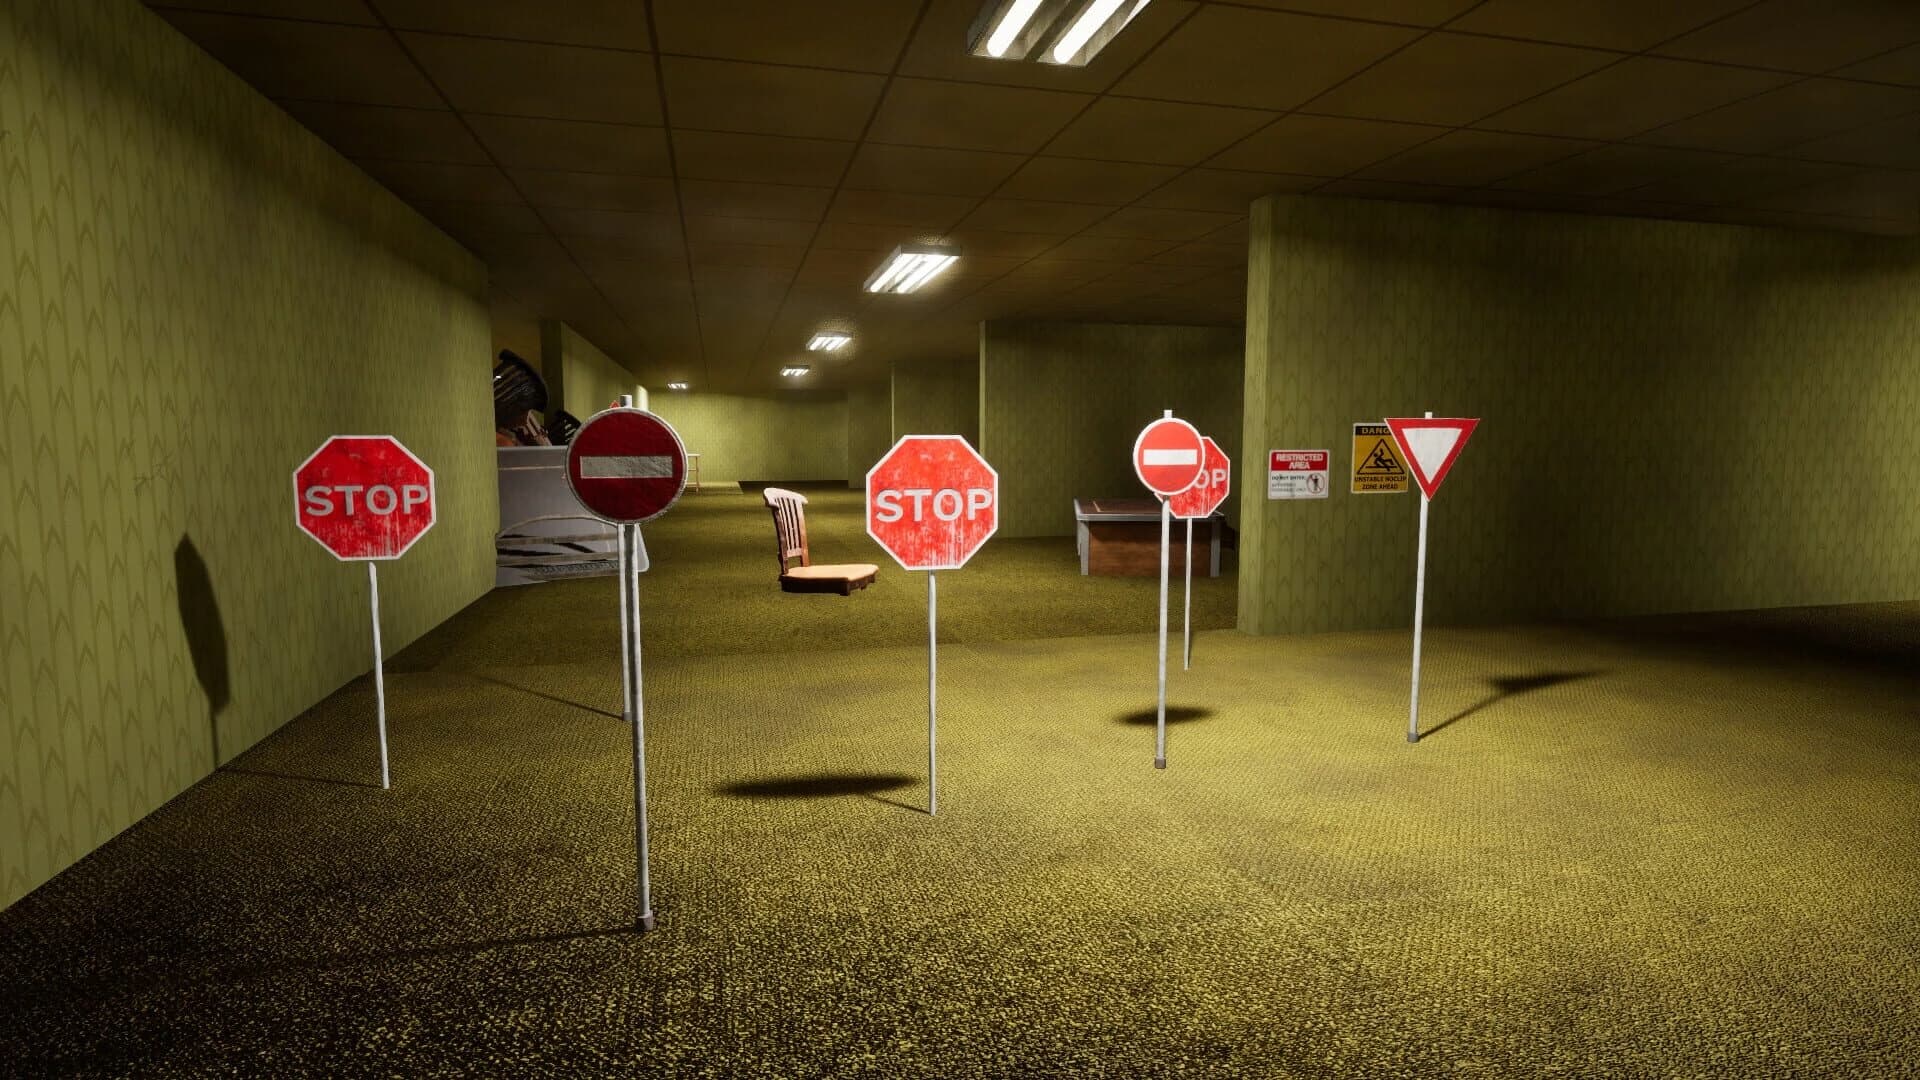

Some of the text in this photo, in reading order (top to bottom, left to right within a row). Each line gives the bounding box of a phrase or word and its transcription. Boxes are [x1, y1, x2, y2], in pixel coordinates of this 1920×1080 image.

[1361, 427, 1390, 435] DANG
[1276, 453, 1323, 462] RESTRICTED
[1194, 468, 1227, 489] OP
[304, 484, 429, 516] STOP
[876, 488, 994, 523] STOP
